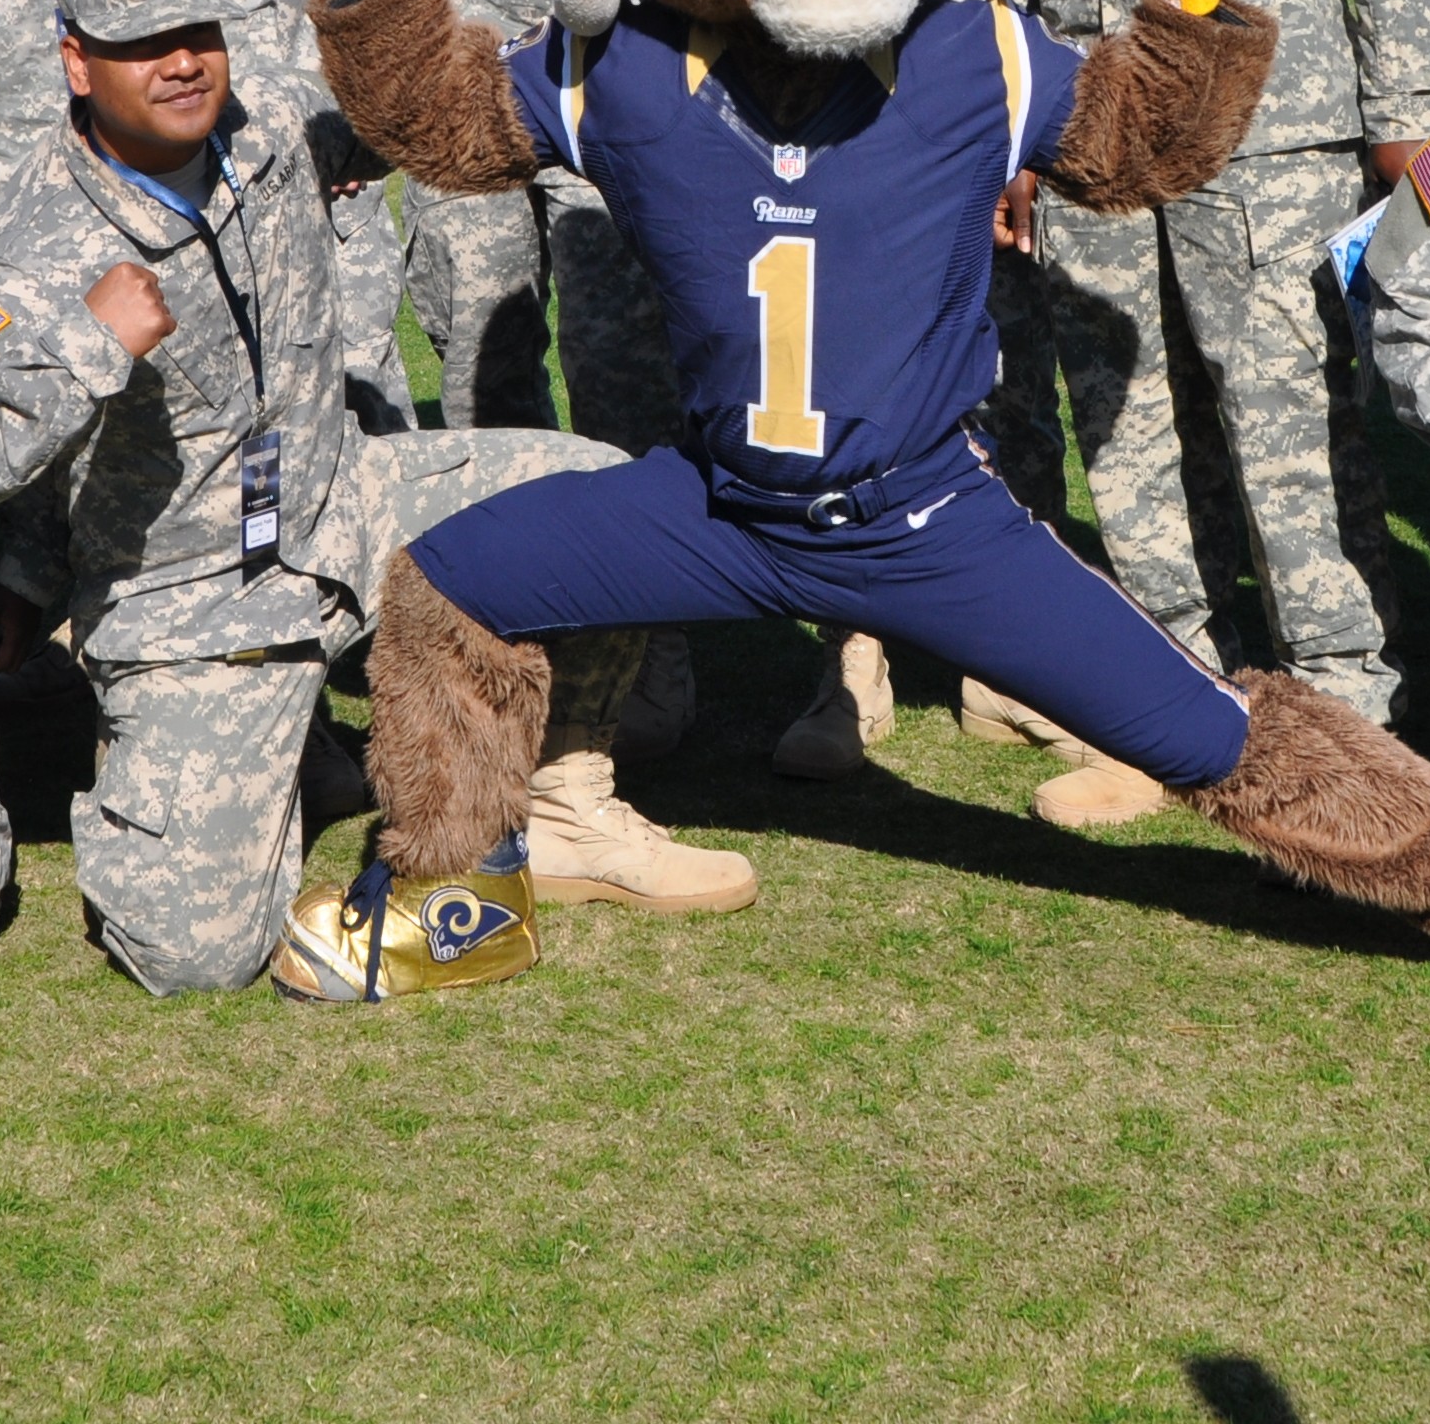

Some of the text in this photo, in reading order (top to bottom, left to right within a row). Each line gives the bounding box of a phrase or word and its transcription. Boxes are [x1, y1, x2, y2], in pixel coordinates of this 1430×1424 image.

[278, 152, 298, 188] ARMY
[778, 160, 800, 174] NFL
[752, 196, 818, 224] Rams
[747, 236, 826, 458] 1
